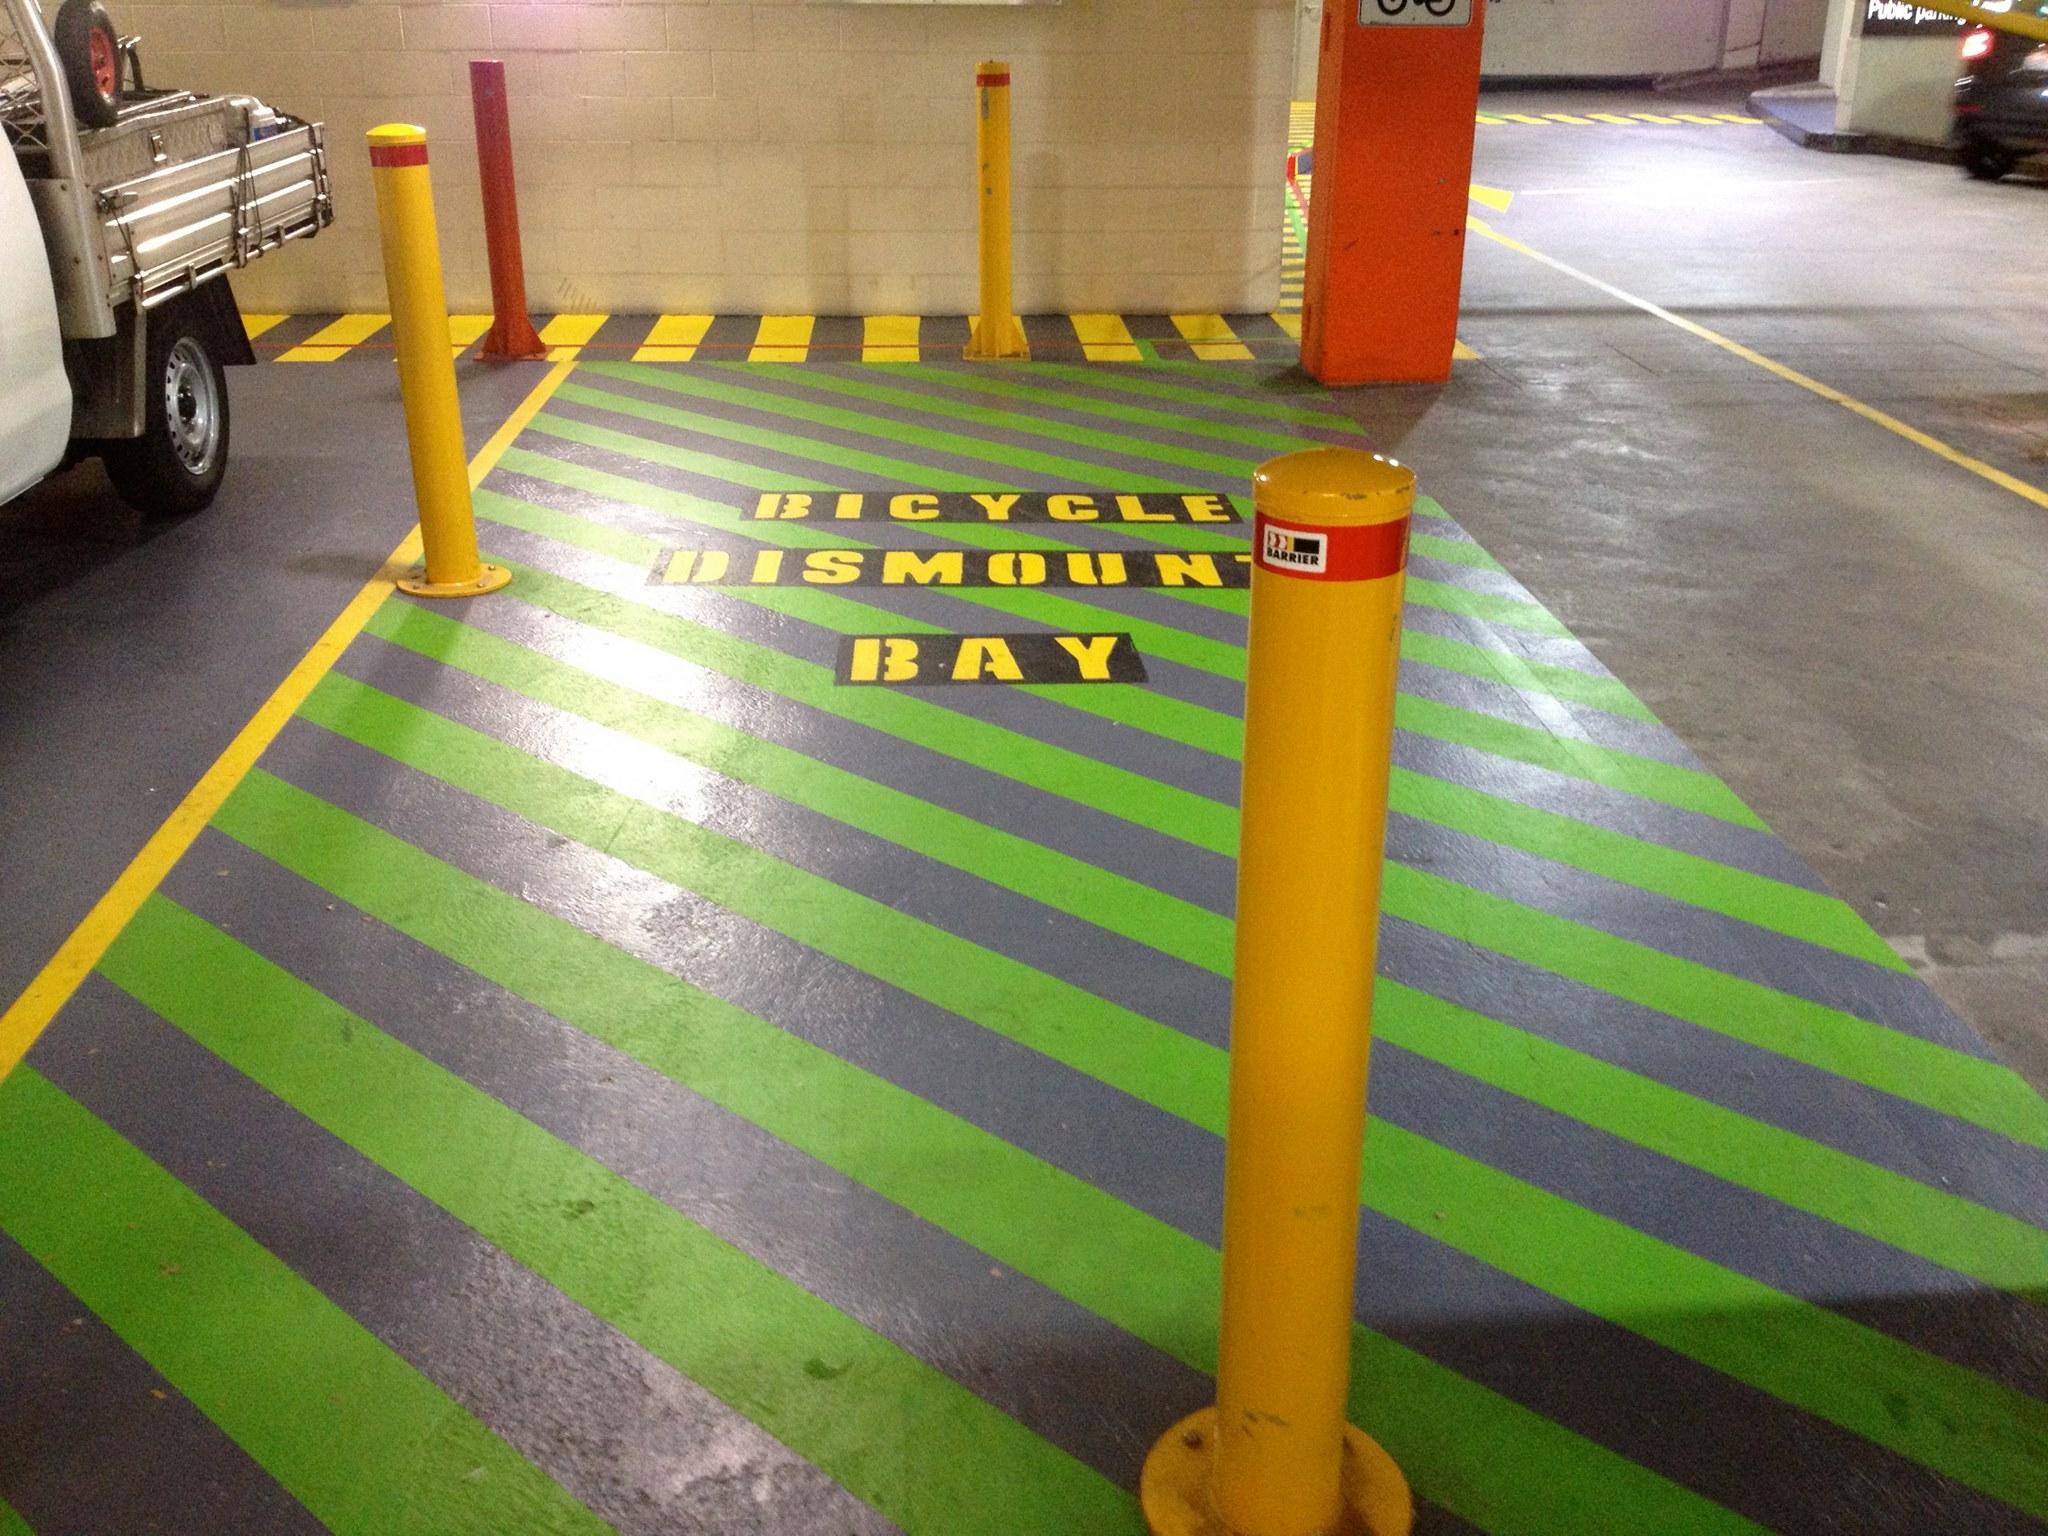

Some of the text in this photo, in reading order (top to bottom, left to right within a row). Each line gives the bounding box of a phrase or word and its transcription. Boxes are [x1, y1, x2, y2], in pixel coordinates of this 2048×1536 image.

[1867, 0, 1967, 26] Public parg
[754, 493, 1231, 522] BICYCLE
[661, 550, 1252, 587] DISMOUN
[1266, 547, 1320, 566] BARRIER
[850, 636, 1119, 681] BAY
